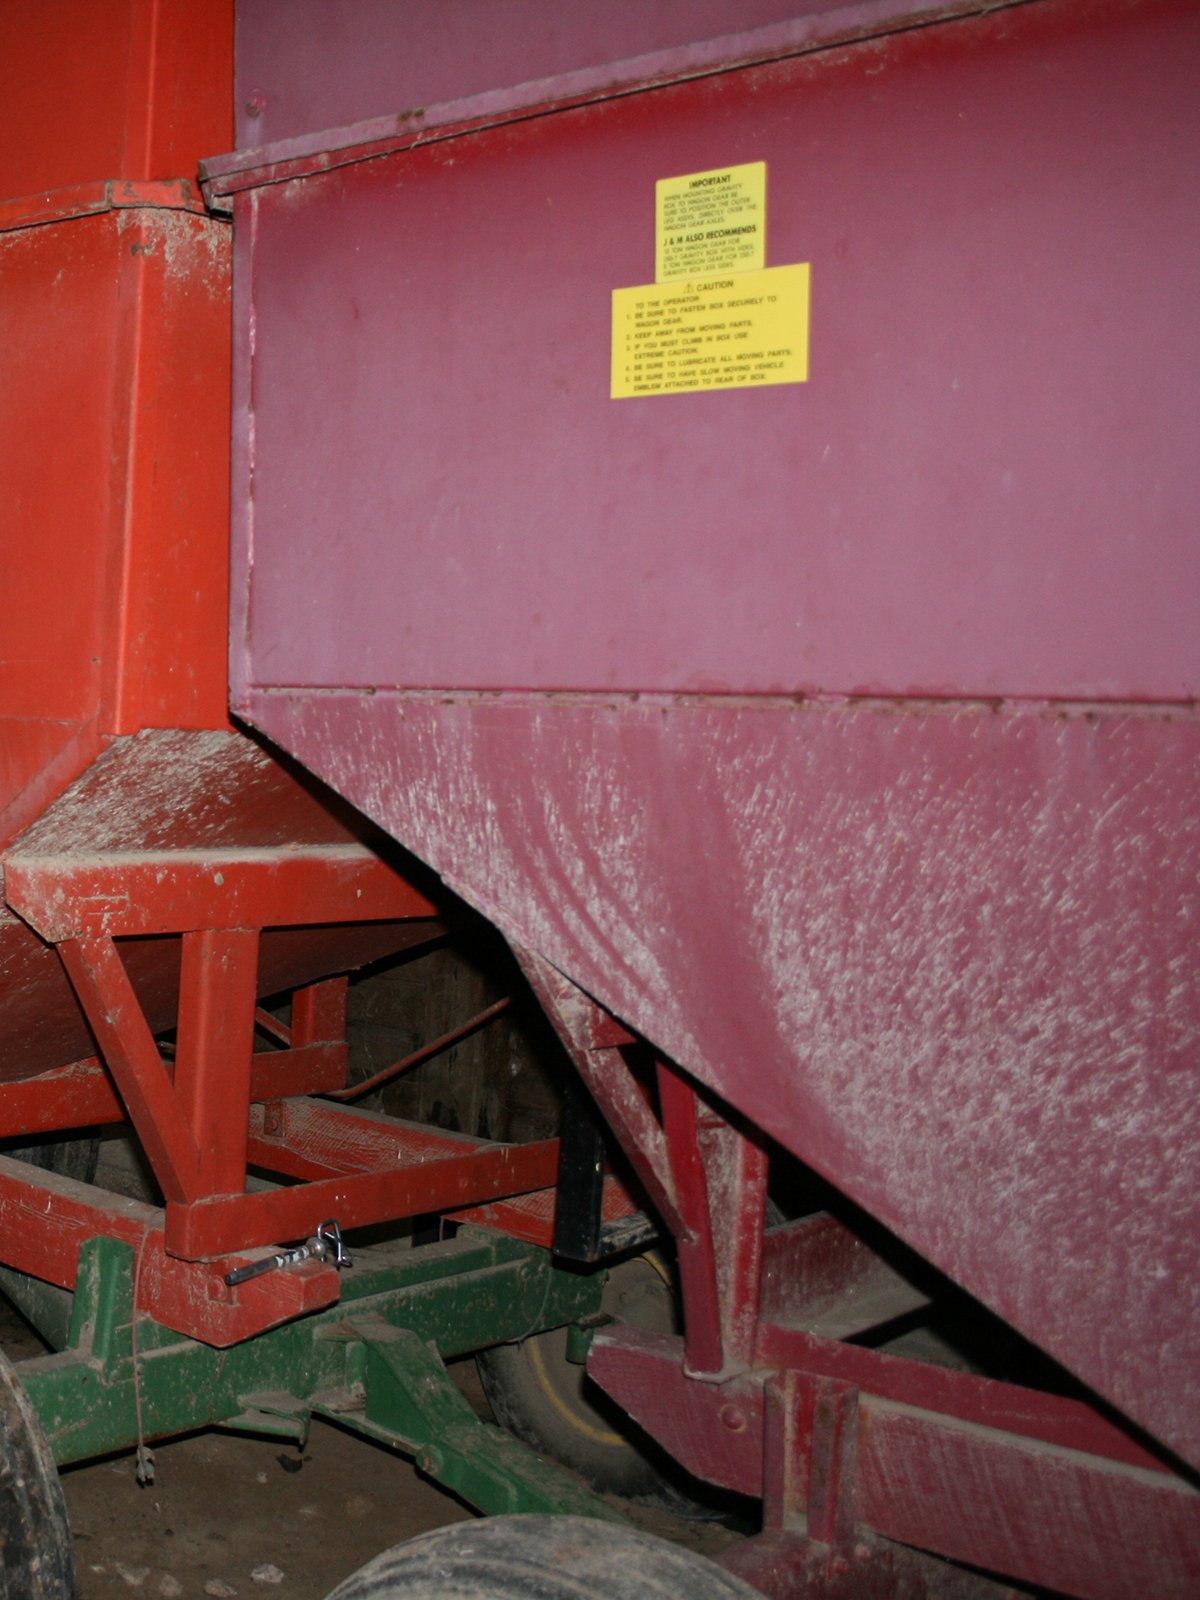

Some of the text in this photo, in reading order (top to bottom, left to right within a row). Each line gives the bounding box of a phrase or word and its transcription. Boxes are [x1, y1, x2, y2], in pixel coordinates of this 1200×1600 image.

[689, 174, 731, 189] IMPORTANT
[717, 183, 742, 193] GRAVITY
[687, 197, 711, 205] WAGON
[712, 193, 729, 201] GEAR
[689, 203, 717, 212] POSITION
[731, 196, 751, 206] OUTER
[664, 224, 757, 247] J & M ALSO RECOMMENDS
[685, 243, 708, 251] WAGON
[728, 237, 740, 245] FOR
[682, 258, 706, 266] WAGON
[696, 280, 734, 292] CAUTION
[634, 311, 643, 319] BE
[647, 309, 664, 317] SURE
[680, 304, 706, 313] FASTEN
[709, 302, 724, 310] BOX
[727, 297, 763, 308] SECURELY
[767, 295, 777, 303] TO
[663, 295, 700, 306] OPERATOR
[634, 331, 652, 339] KEEP
[655, 329, 673, 337] AWAY
[676, 326, 696, 334] FROM
[698, 323, 726, 332] MOVING
[635, 320, 660, 328] WAGON
[644, 341, 658, 349] YOU
[660, 339, 679, 347] MUST
[681, 337, 703, 345] CLIMB
[716, 333, 731, 341] BOX
[734, 331, 748, 340] USE
[634, 350, 665, 360] EXTREME
[646, 361, 663, 370] SURE
[679, 356, 716, 367] LUBRICATE
[735, 351, 764, 361] MOVING
[646, 372, 663, 381] SURE
[667, 371, 676, 379] TO
[700, 367, 720, 375] SLOW
[723, 364, 751, 373] MOVING
[755, 361, 784, 370] VEHICLE
[633, 383, 661, 392] EMBLEM
[664, 379, 699, 389] ATTACHED
[702, 377, 712, 385] TO
[714, 375, 734, 384] REAR
[737, 374, 746, 382] OF
